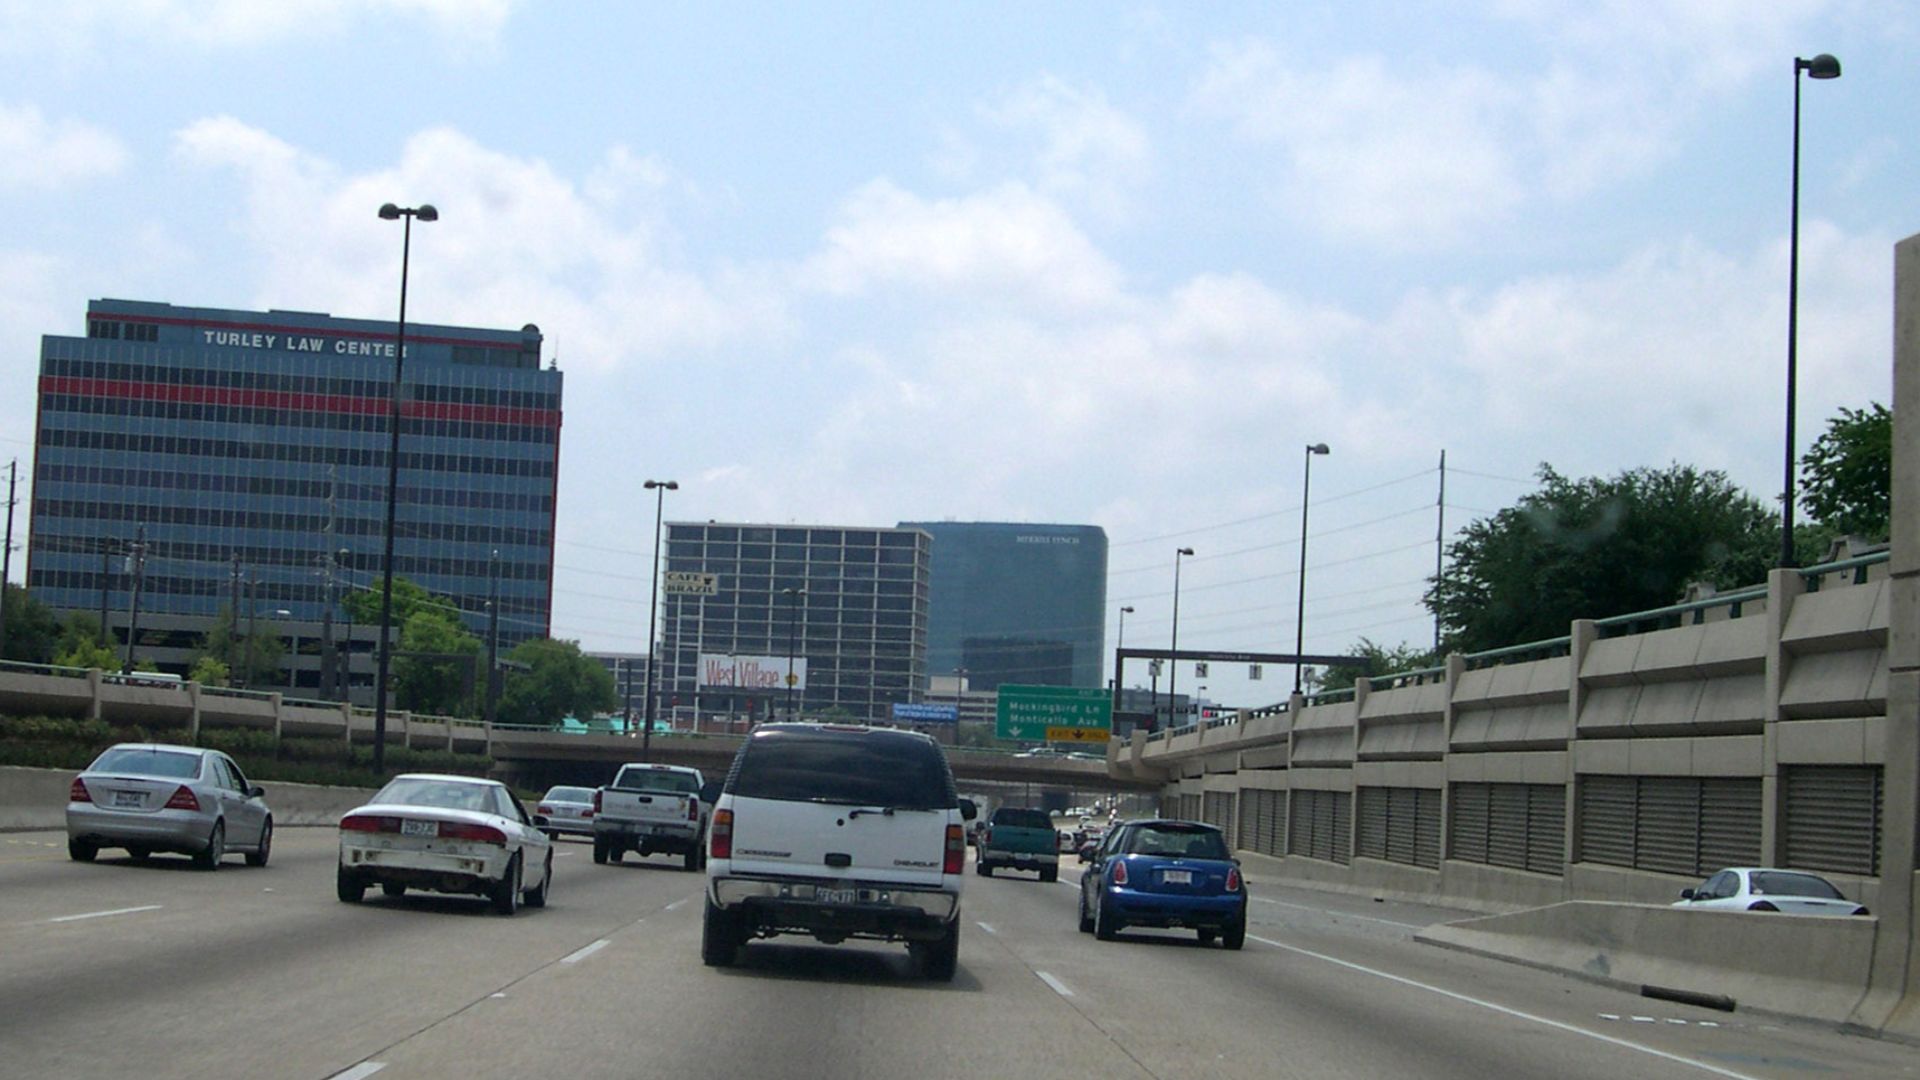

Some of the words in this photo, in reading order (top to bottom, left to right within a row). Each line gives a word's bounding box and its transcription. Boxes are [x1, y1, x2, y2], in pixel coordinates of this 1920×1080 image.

[204, 330, 276, 349] TURLEY
[287, 337, 324, 352] LAW
[667, 573, 700, 581] CAFE
[667, 584, 714, 594] BRAZIL
[739, 661, 780, 688] Village
[1009, 702, 1078, 713] Mockingbird
[1085, 705, 1100, 714] Ln
[1010, 714, 1068, 725] Monticello
[1078, 717, 1098, 726] Ave
